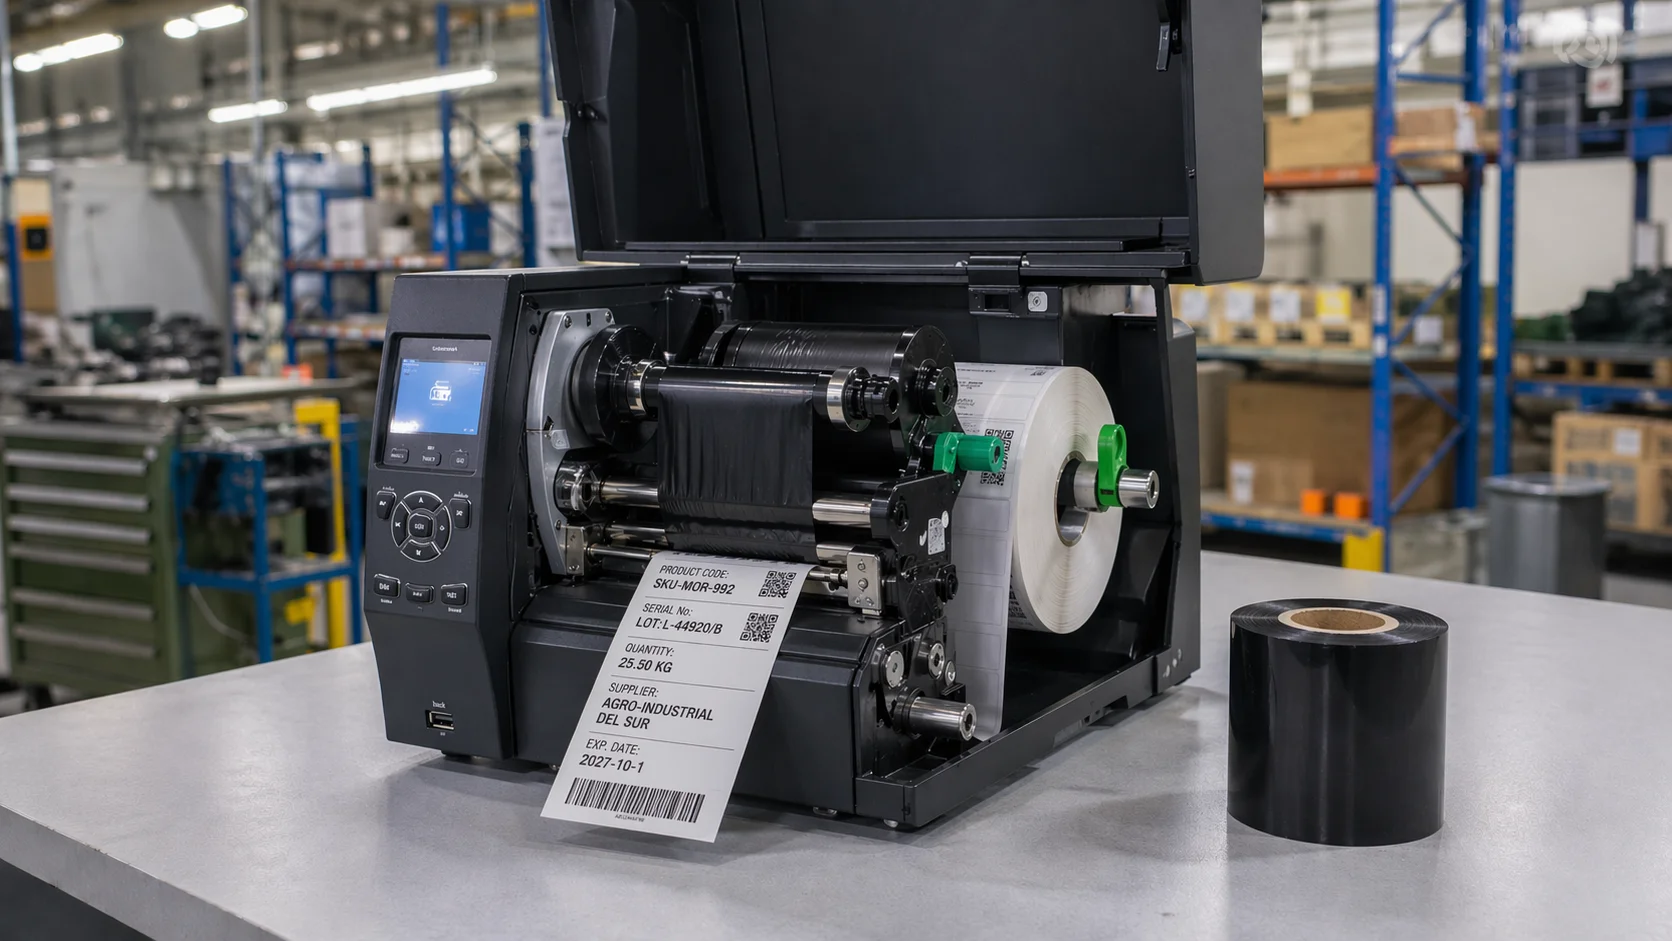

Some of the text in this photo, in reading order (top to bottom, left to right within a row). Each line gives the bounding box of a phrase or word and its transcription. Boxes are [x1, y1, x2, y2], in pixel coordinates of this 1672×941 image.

[659, 565, 730, 579] PRODUCT CODE:
[653, 578, 735, 595] SKU-MOR-992
[642, 603, 693, 617] SERIAL No:
[625, 643, 674, 657] QUANTITY:
[618, 657, 673, 673] 25.50 KG
[609, 682, 659, 697] SUPPLIER:
[601, 697, 714, 721] AGRO-INDUSTRIAL
[596, 712, 650, 730] DEL SUR
[586, 738, 640, 756] EXP. DATE:
[578, 754, 645, 774] 2027-10-1
